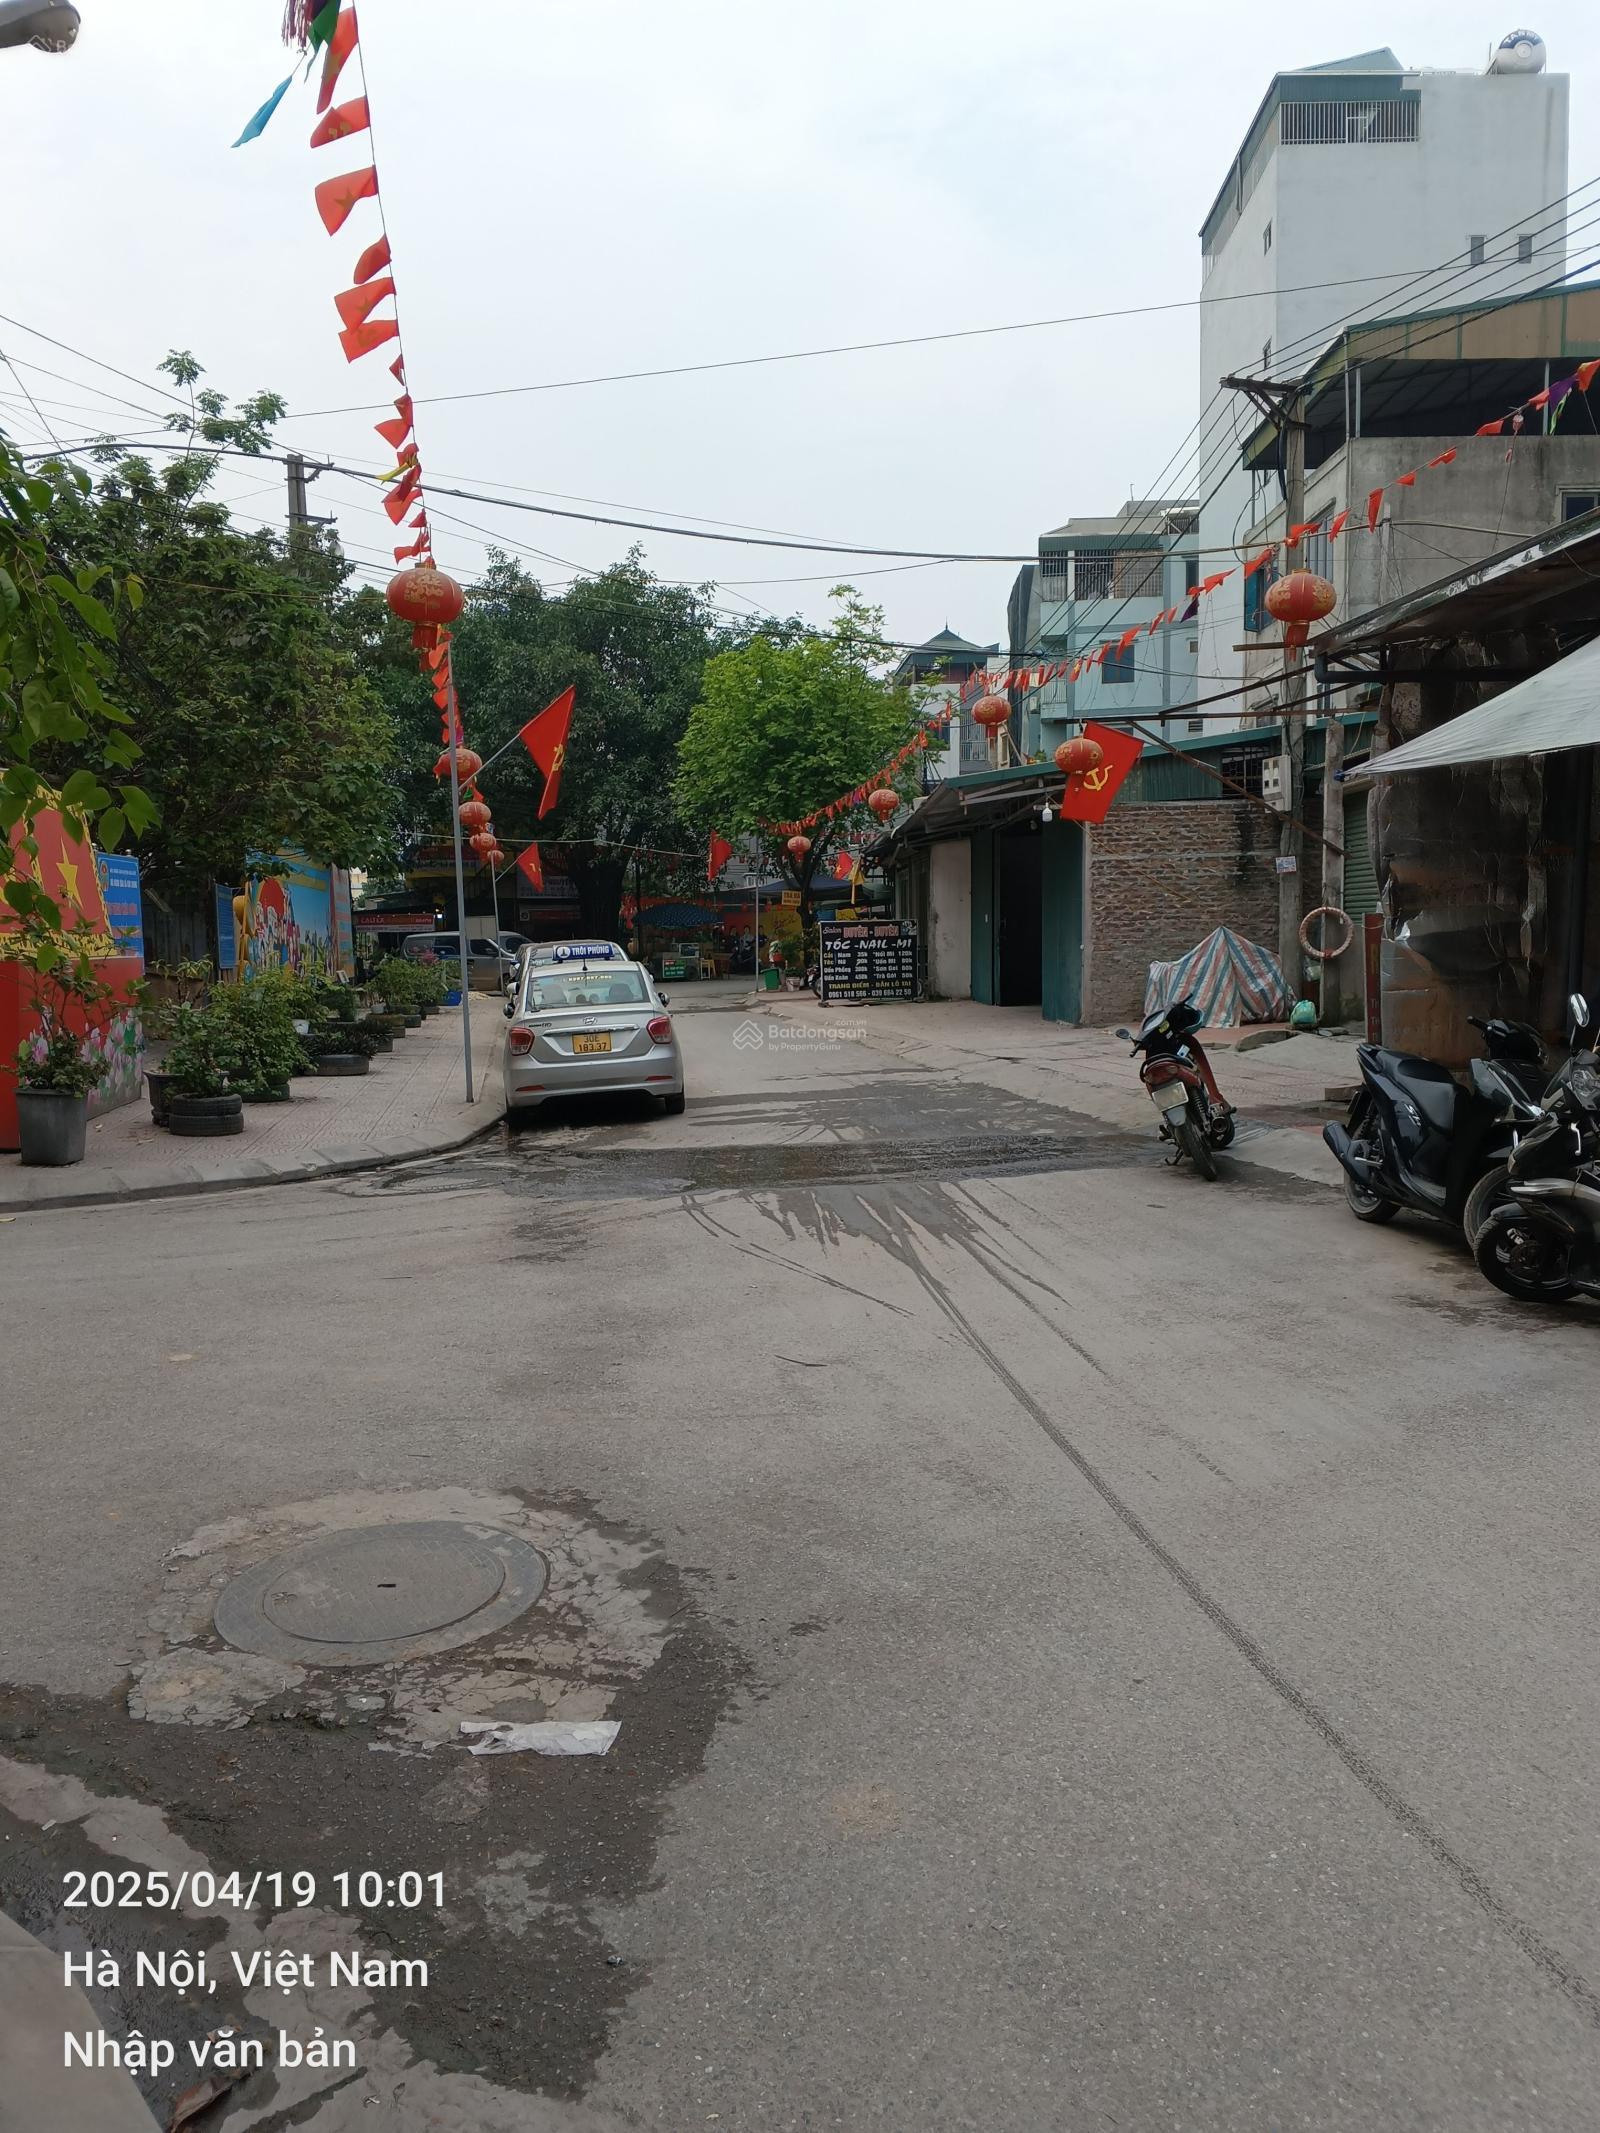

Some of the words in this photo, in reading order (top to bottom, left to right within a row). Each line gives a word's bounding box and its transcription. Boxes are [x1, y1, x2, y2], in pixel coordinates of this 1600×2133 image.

[825, 938, 851, 950] TÓC
[584, 1034, 600, 1043] 30E
[578, 1042, 607, 1052] 183.37
